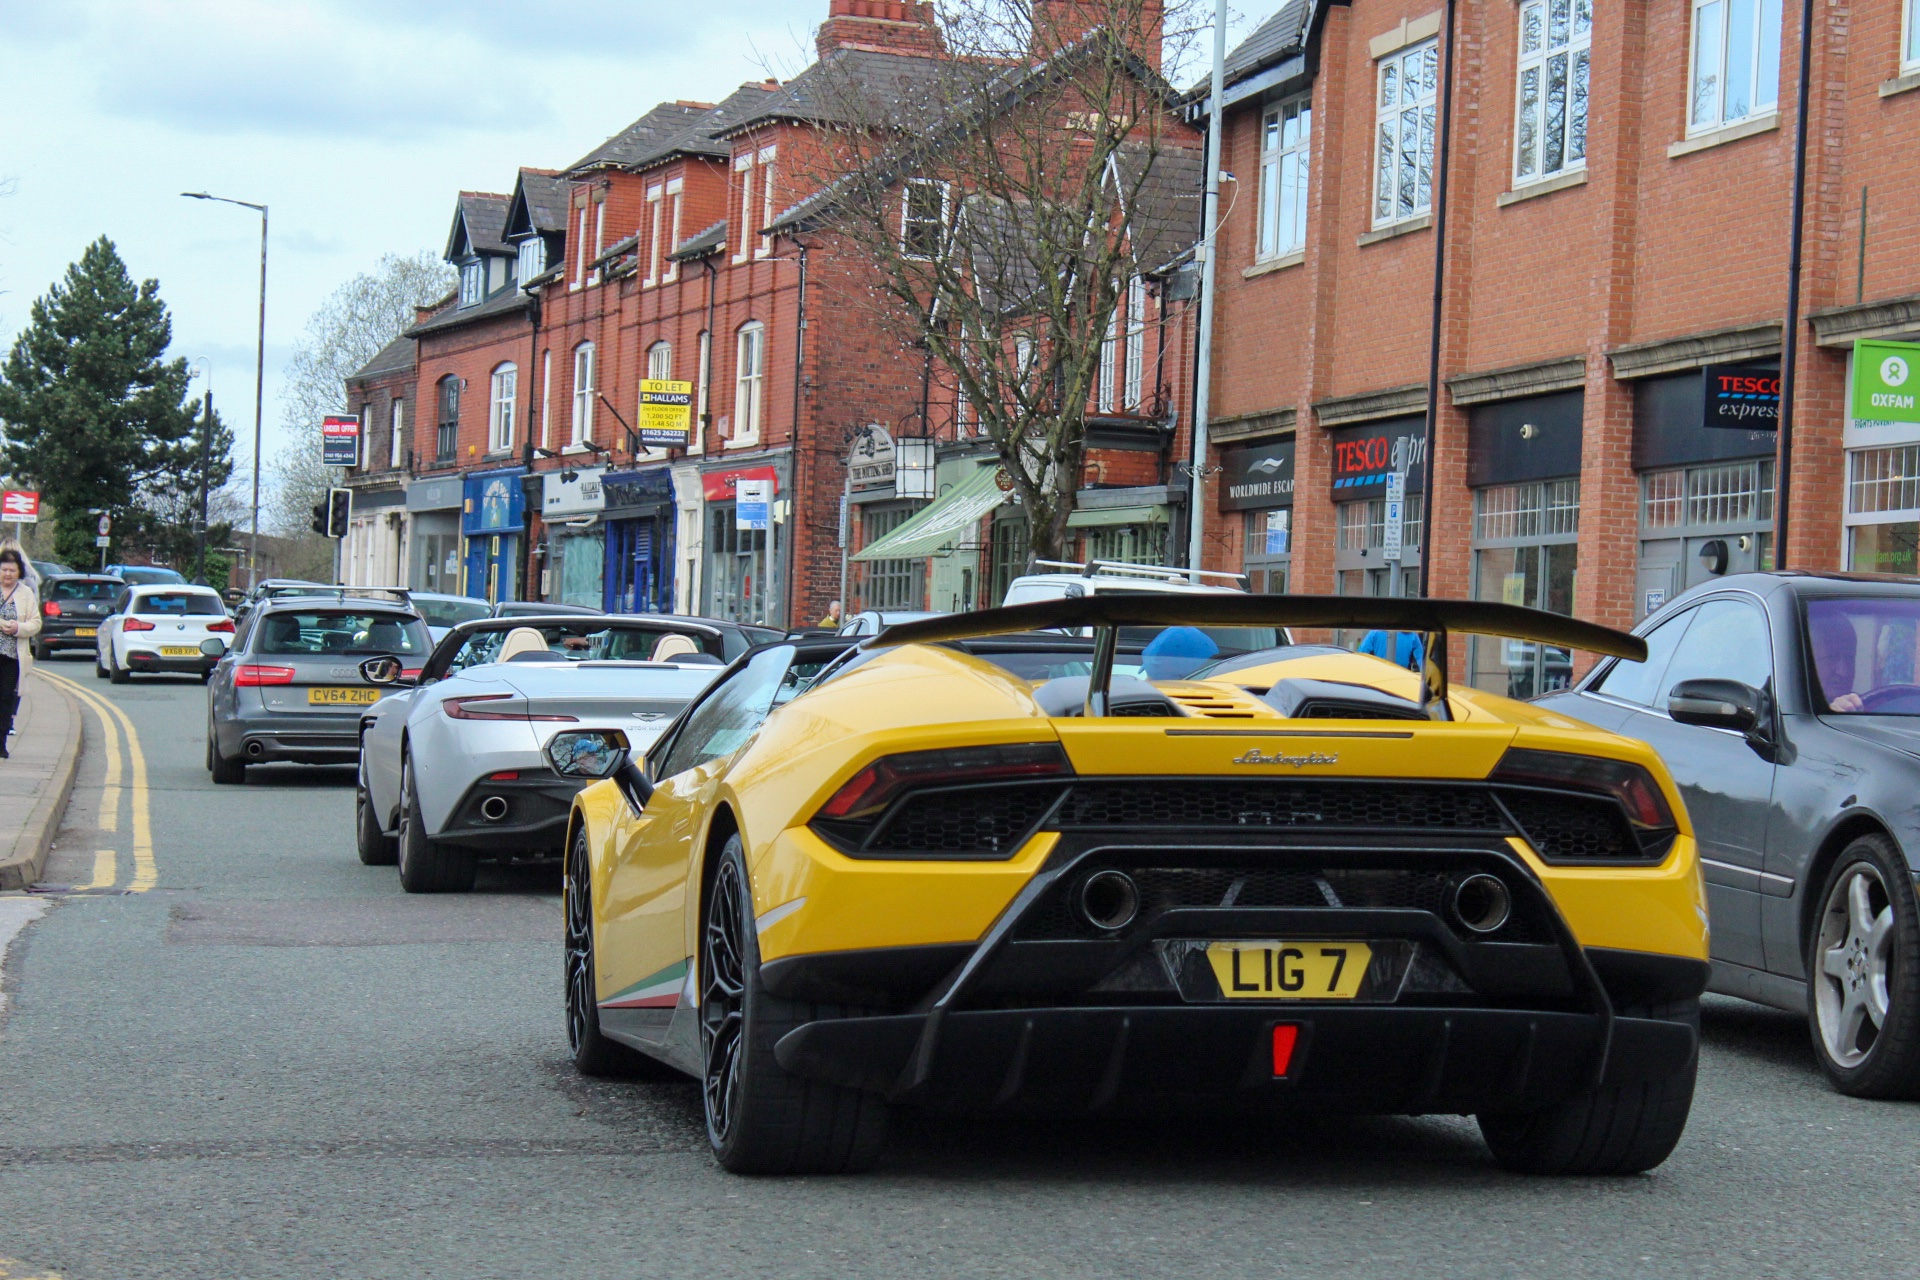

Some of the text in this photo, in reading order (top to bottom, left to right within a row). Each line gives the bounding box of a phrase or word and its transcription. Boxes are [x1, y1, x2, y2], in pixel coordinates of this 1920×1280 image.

[649, 382, 683, 391] TO LET
[650, 394, 688, 403] HALLAMS
[1871, 393, 1914, 409] OXFAM
[323, 424, 357, 433] UNDER OFFER
[1335, 436, 1389, 473] TESCO
[1229, 481, 1272, 499] WORLDWIDE
[164, 646, 183, 655] VX68
[313, 690, 375, 702] CV64 ZHC
[1232, 748, 1339, 769] Lamborghini
[1320, 948, 1347, 992] 7
